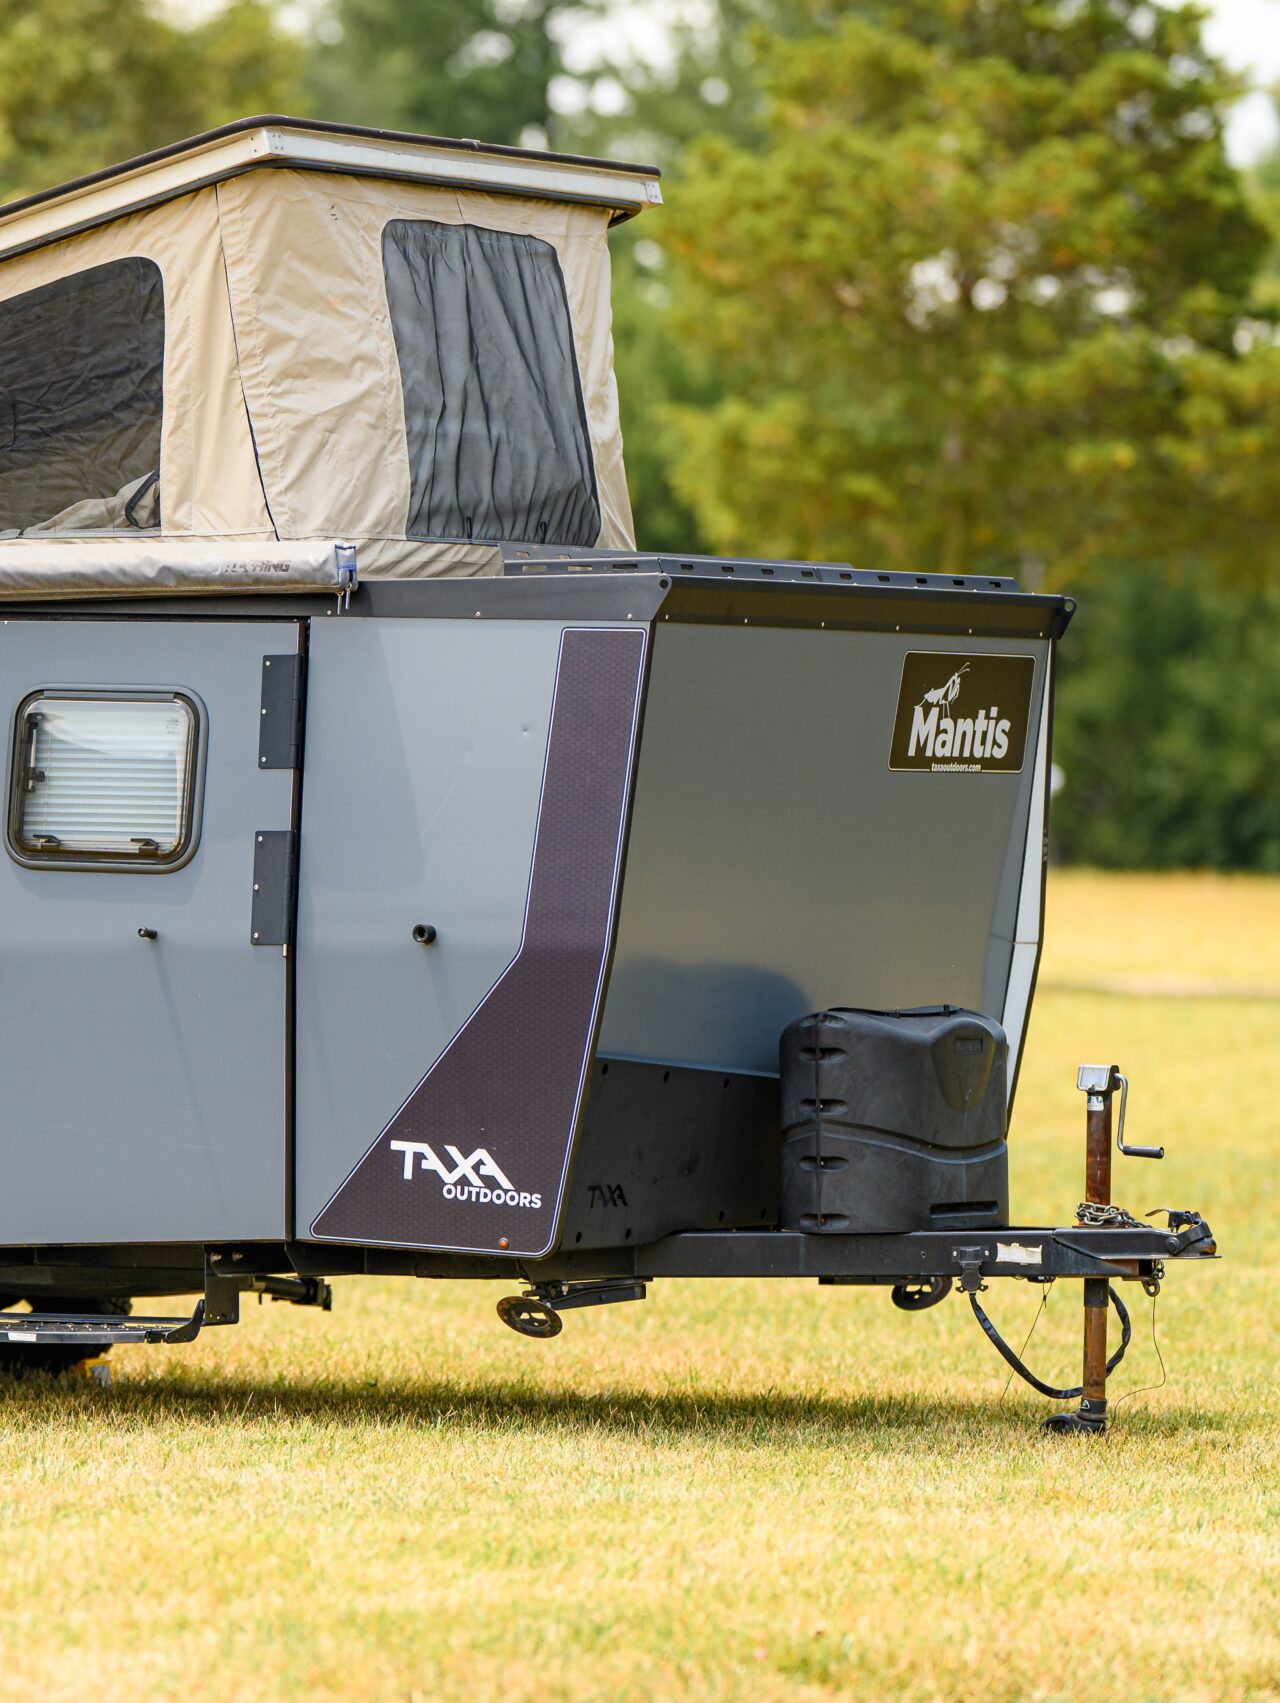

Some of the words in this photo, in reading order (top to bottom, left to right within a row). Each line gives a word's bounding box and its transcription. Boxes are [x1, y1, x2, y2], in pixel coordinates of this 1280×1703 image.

[907, 706, 1011, 759] Mantis
[931, 762, 982, 773] taxaoutdoors.com
[390, 1140, 515, 1190] TAXA
[442, 1184, 542, 1209] OUTDOORS
[587, 1184, 628, 1208] TAXA
